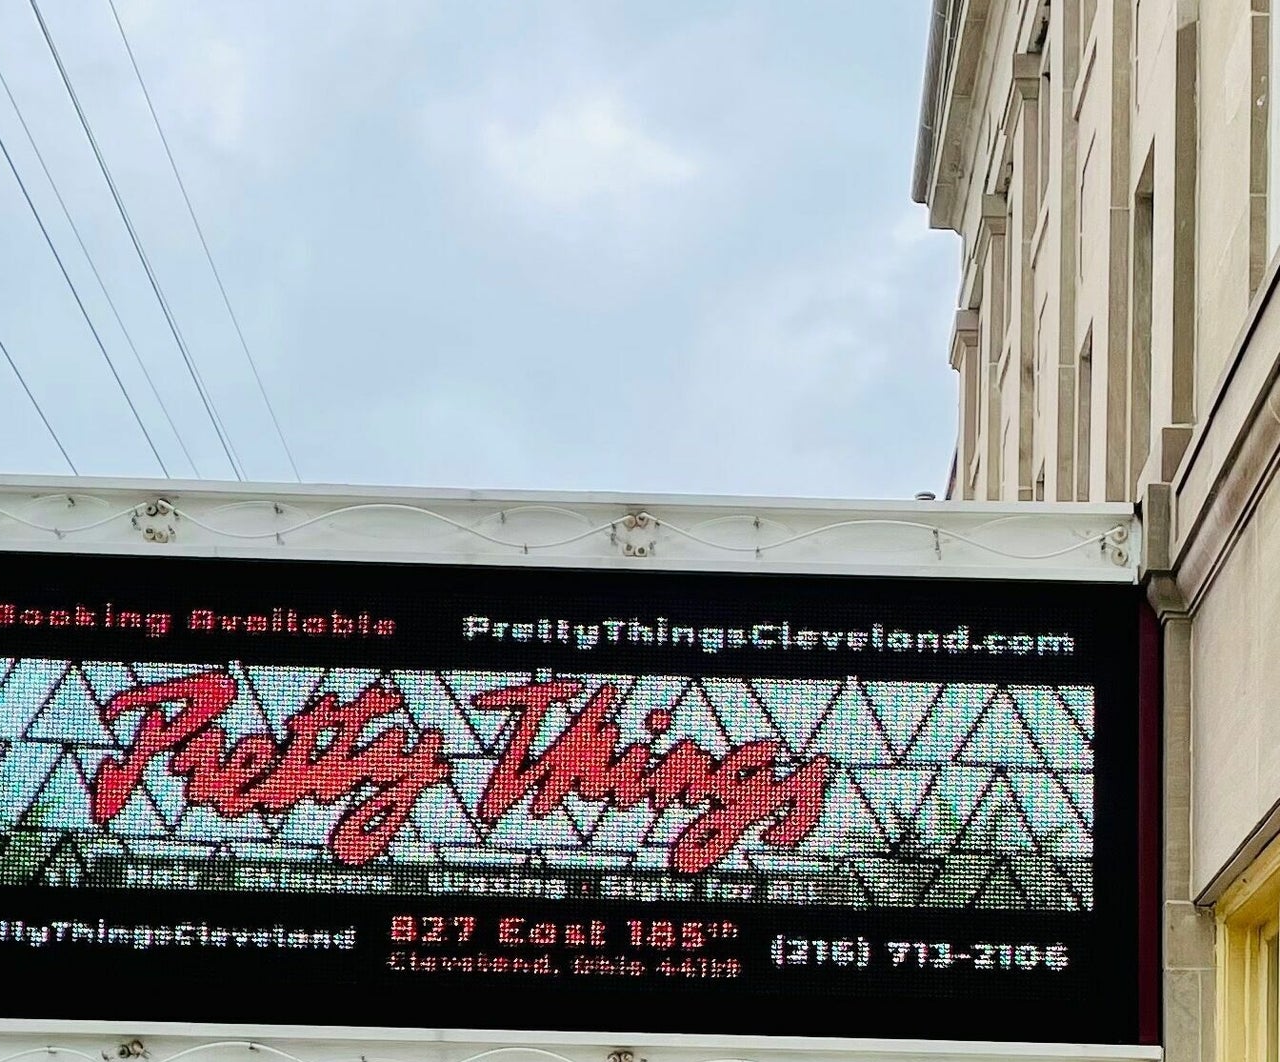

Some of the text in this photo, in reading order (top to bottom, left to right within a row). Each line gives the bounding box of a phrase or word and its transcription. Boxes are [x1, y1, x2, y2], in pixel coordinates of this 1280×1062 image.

[187, 607, 396, 636] Available
[462, 615, 1075, 655] PrettyThingsCleveland.com
[96, 672, 833, 872] Pretty Things
[390, 915, 739, 950] 827 East 185th
[386, 951, 559, 976] Cleveland,
[573, 954, 646, 976] Ohio
[770, 934, 1070, 971] (216) 713-2106
